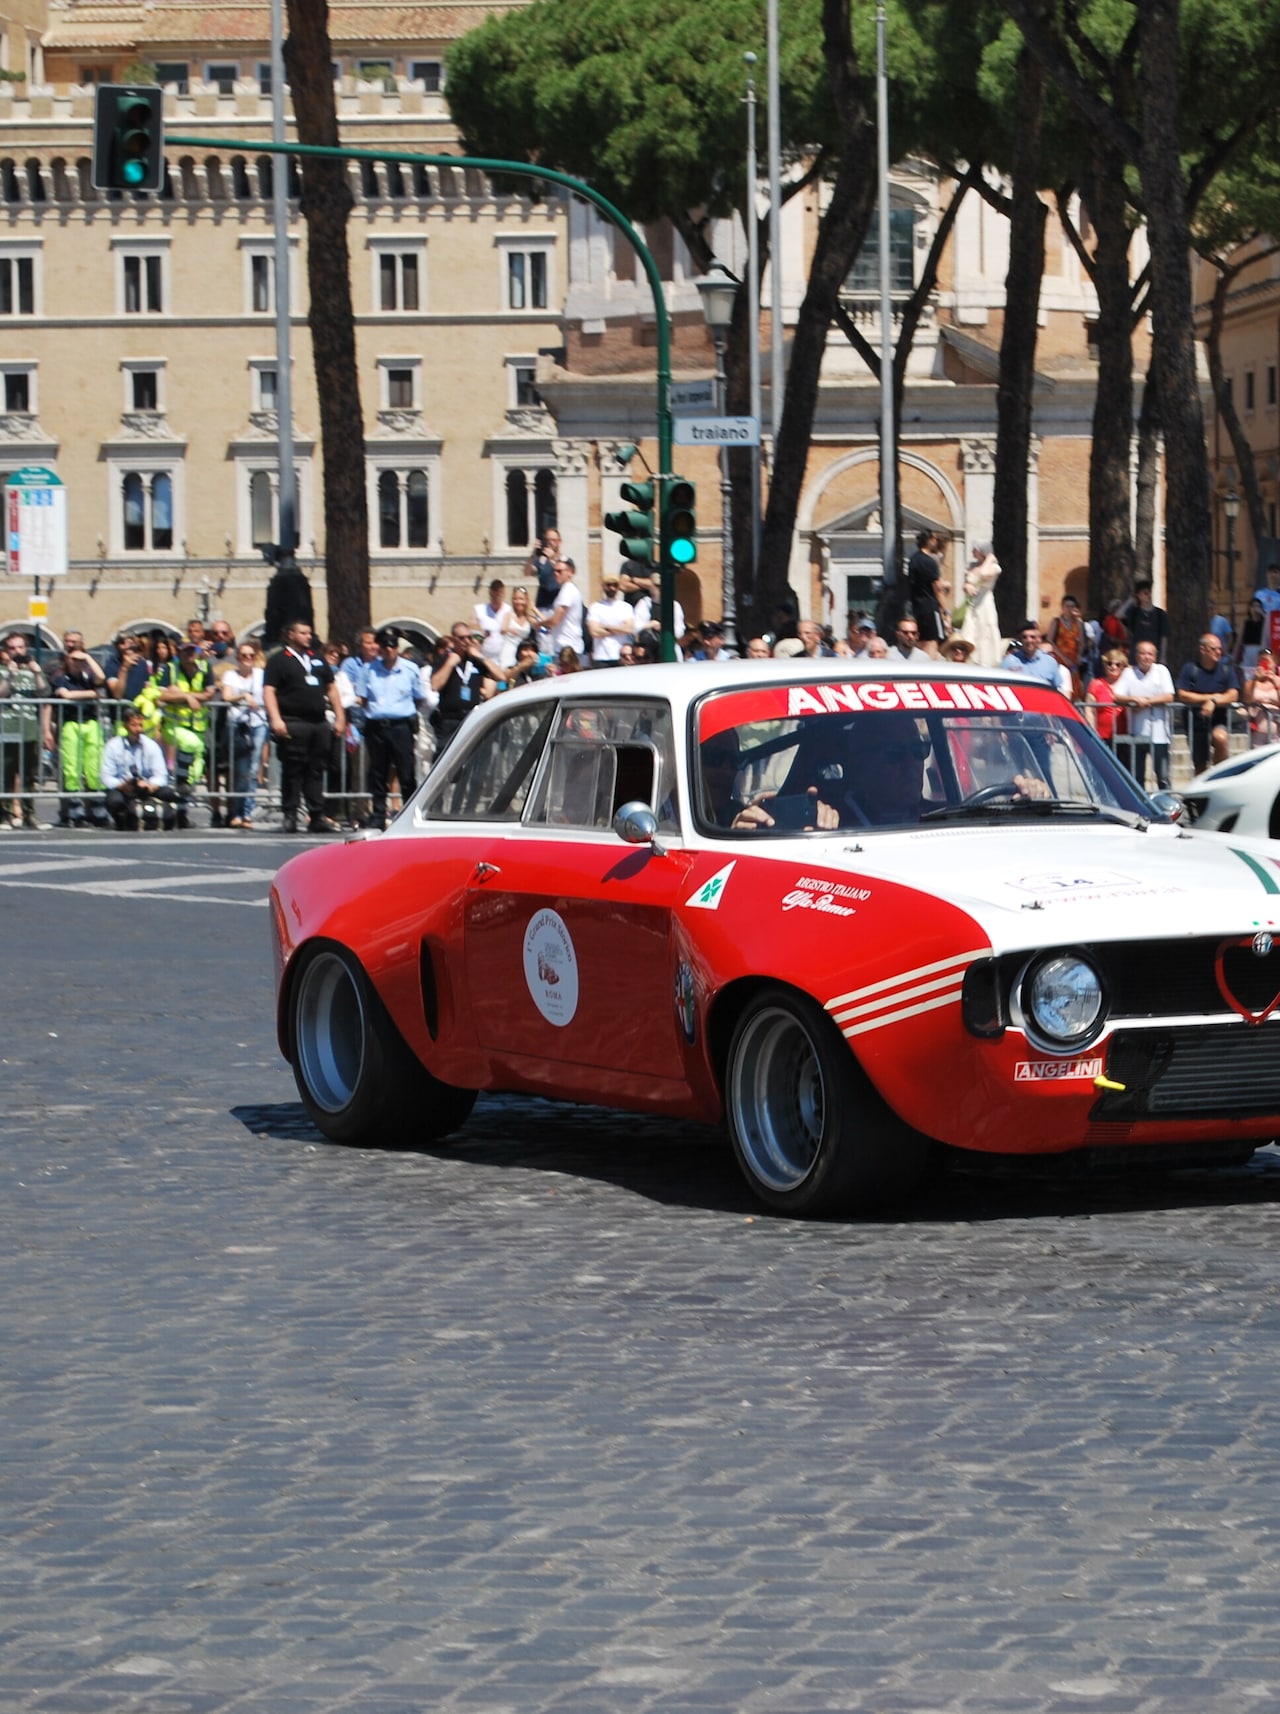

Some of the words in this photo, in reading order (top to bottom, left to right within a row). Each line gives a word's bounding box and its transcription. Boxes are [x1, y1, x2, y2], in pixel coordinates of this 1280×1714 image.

[691, 424, 749, 440] traiano
[788, 682, 1024, 716] ANGELINI
[795, 877, 834, 892] REGISTRO
[831, 884, 871, 901] ITALIANO
[1018, 1060, 1100, 1079] ANGELINI
